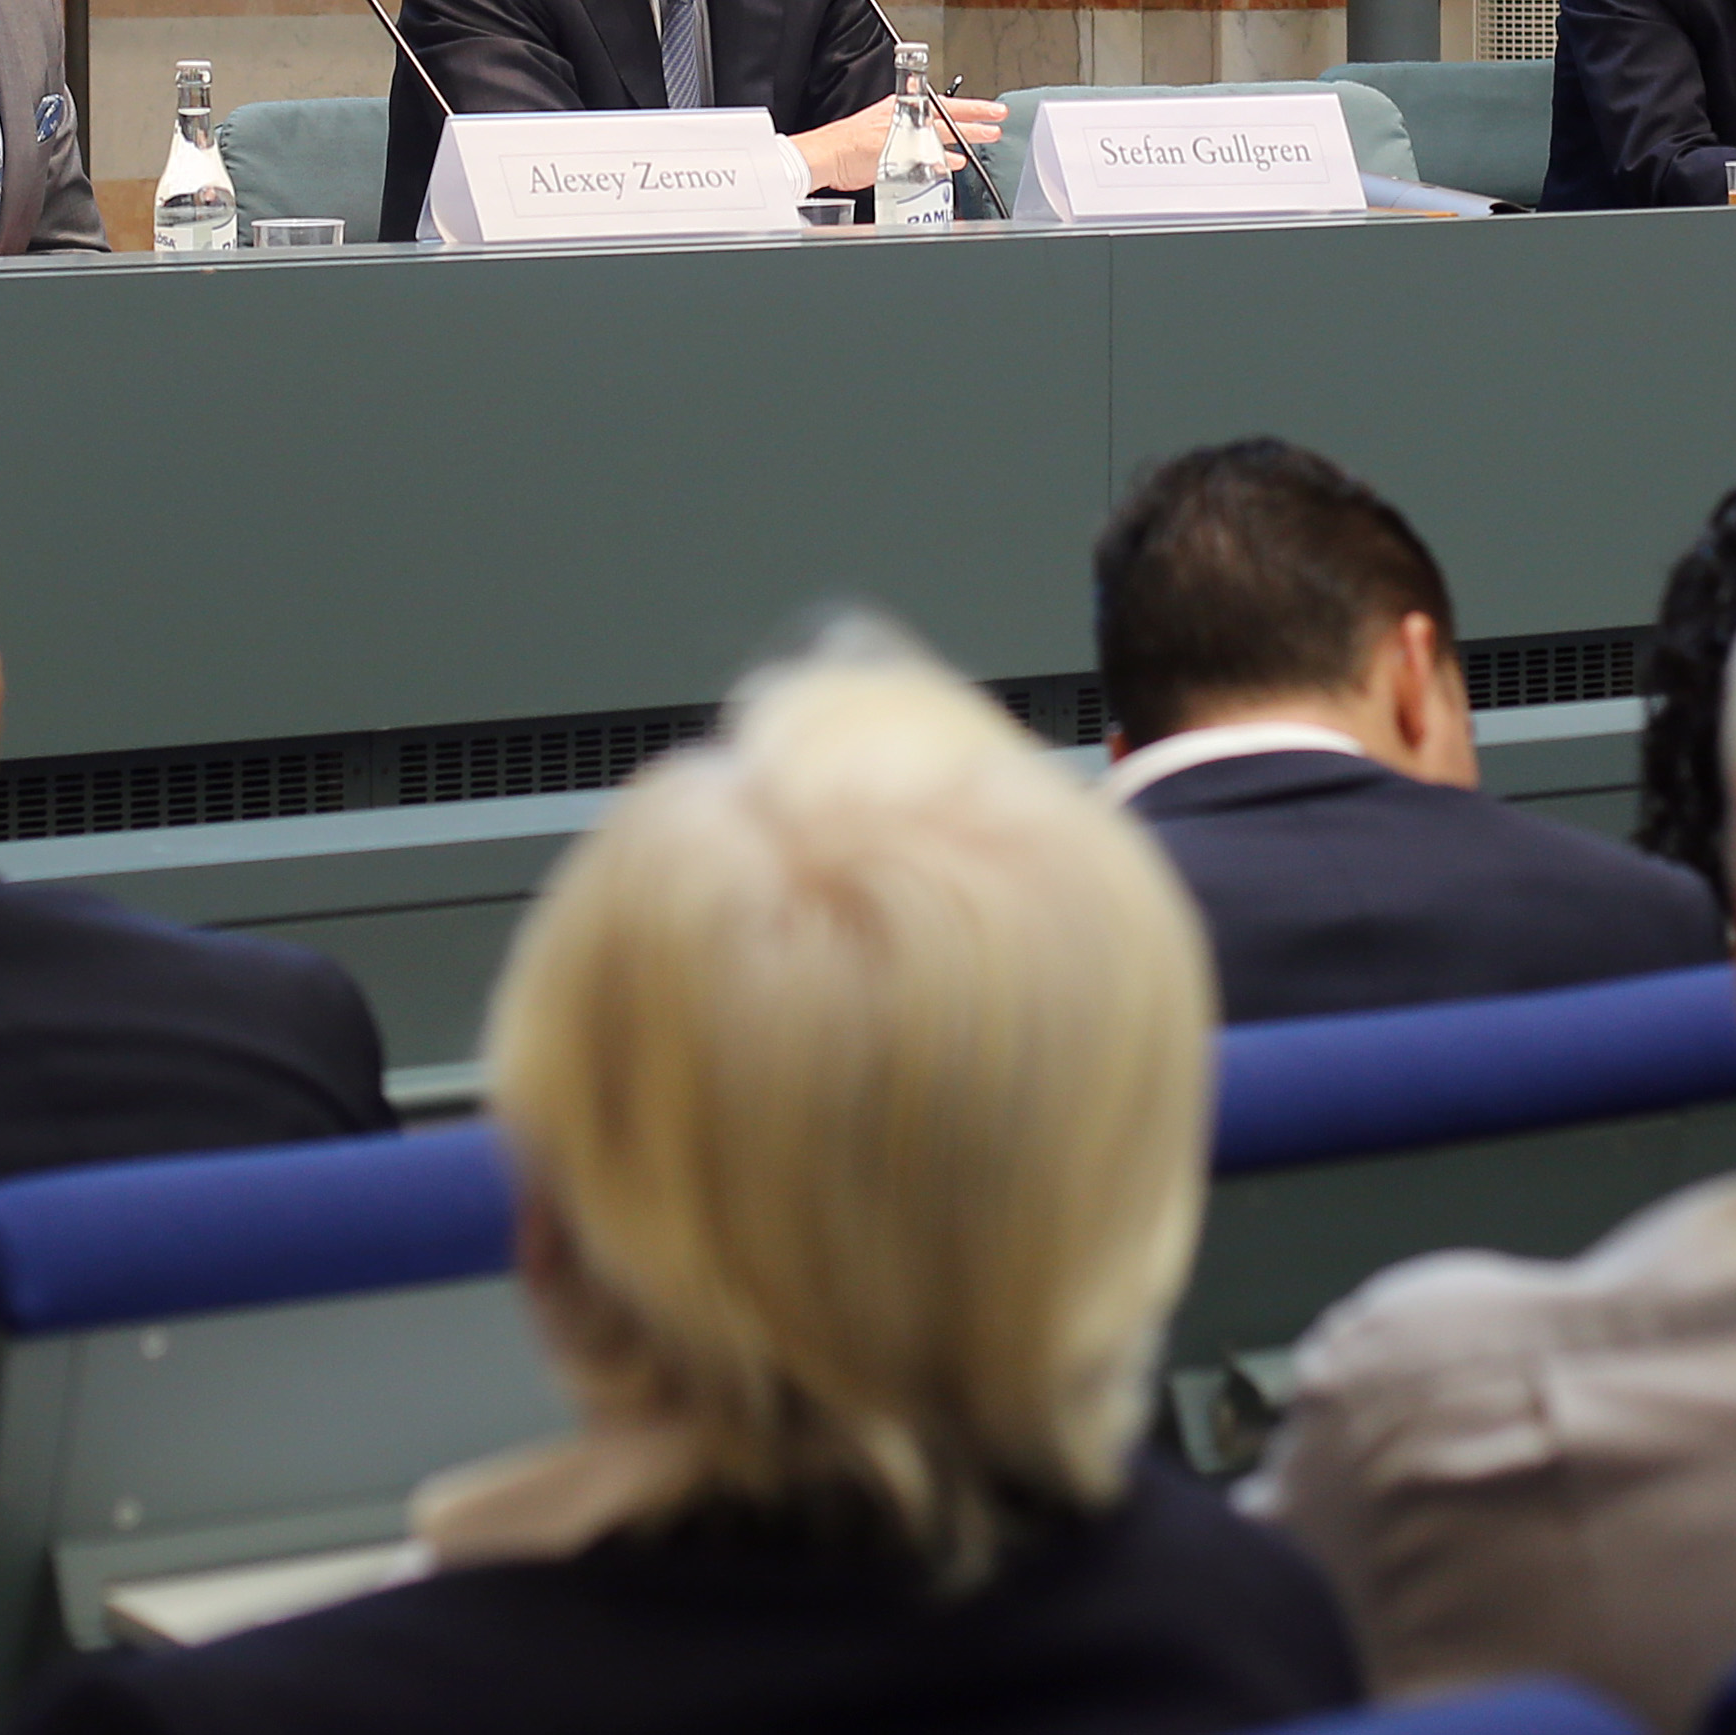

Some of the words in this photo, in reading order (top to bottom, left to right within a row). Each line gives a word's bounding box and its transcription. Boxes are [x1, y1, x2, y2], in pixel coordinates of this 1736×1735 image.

[1099, 135, 1186, 166] Stefan
[1192, 134, 1312, 172] Gullgren
[529, 162, 626, 201] Alexey
[632, 161, 738, 191] Zernov
